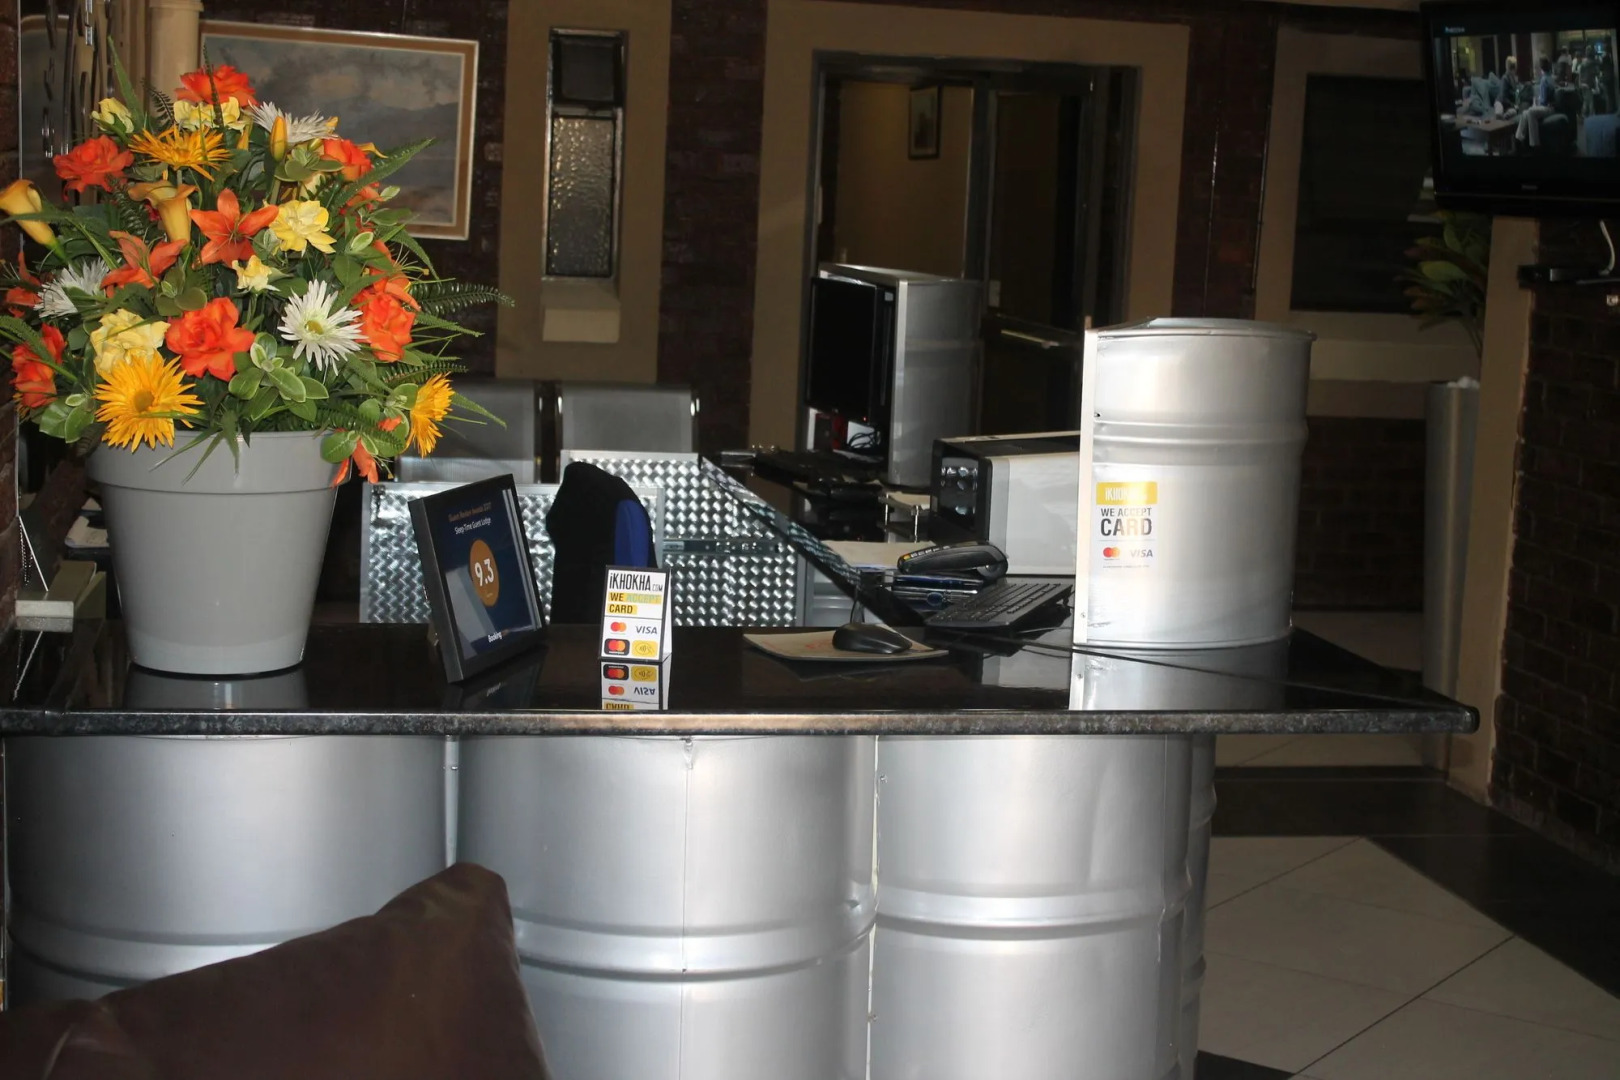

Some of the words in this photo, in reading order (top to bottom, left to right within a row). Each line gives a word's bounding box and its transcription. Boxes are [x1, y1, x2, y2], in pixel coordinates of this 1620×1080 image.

[1101, 508, 1115, 517] WE
[1117, 507, 1152, 517] ACCEPT
[472, 519, 482, 529] Guest
[1100, 518, 1152, 537] CARD
[1130, 549, 1154, 558] VISA
[474, 558, 495, 587] 9.3
[610, 592, 624, 602] WE
[609, 604, 633, 614] CARD
[636, 625, 658, 634] VISA
